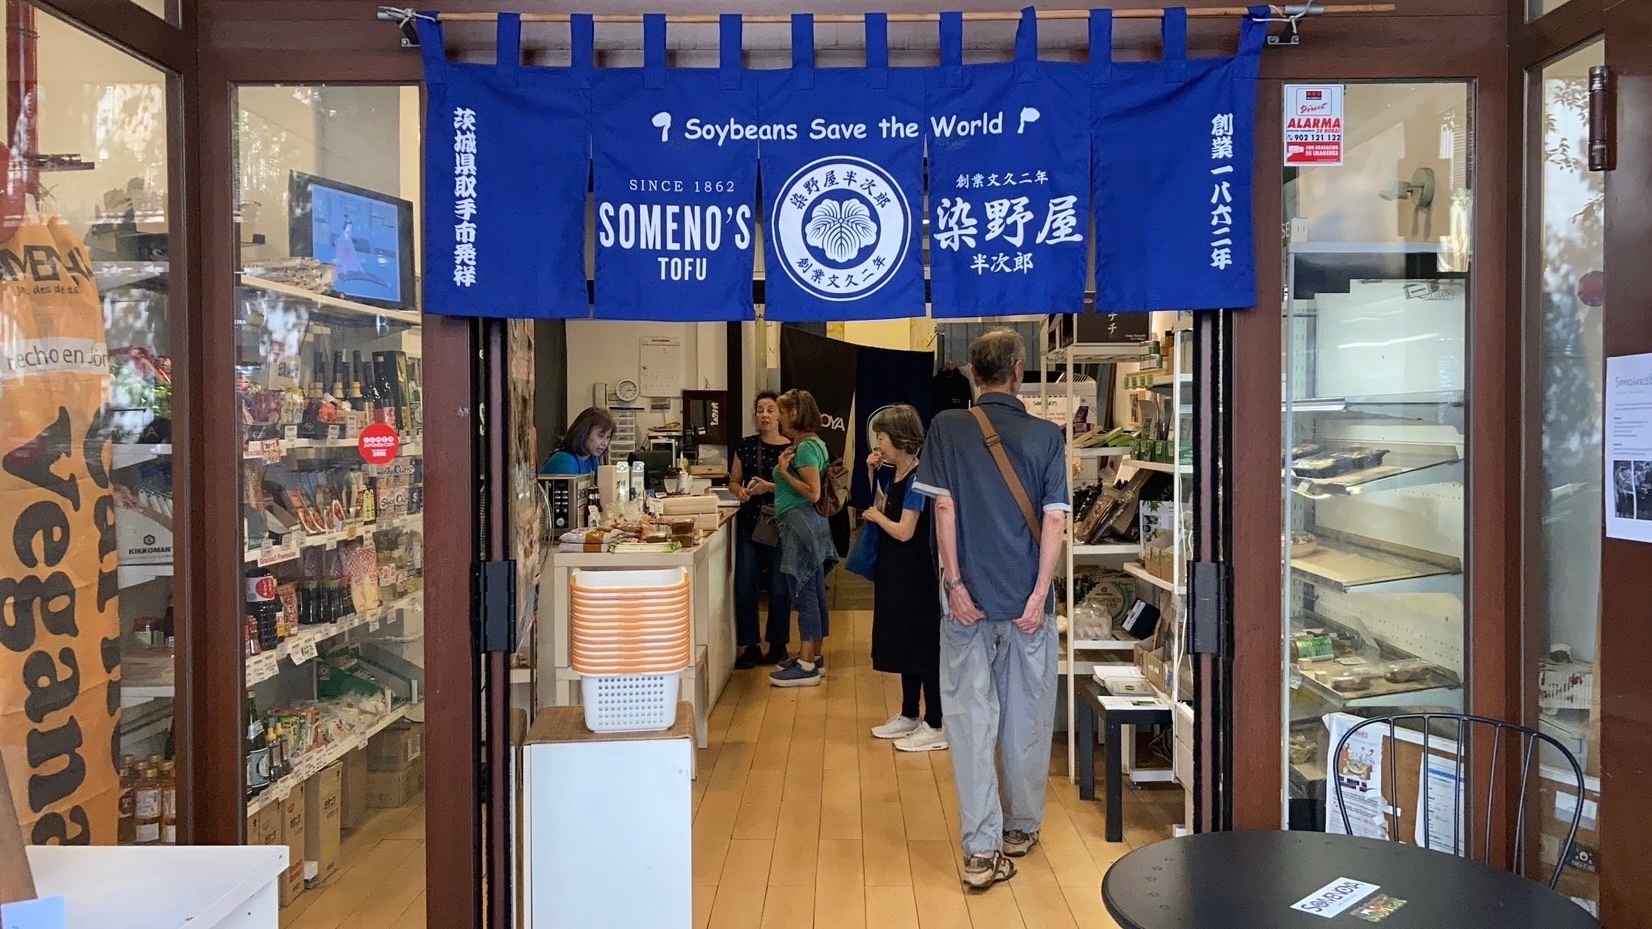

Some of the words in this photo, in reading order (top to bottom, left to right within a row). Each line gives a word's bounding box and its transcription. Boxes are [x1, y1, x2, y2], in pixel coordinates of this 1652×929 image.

[685, 117, 798, 146] Soybeans
[809, 118, 867, 140] Save
[879, 114, 920, 138] the
[931, 111, 1003, 138] World
[1287, 117, 1341, 128] ALARMA
[629, 178, 684, 193] SINCE
[694, 179, 735, 193] 1862
[790, 170, 891, 210] 染野屋半次郎
[956, 169, 1049, 189] 創業文久二年
[1210, 113, 1234, 270] 創業一八六二年
[454, 107, 477, 287] 茨城県取手市発祥
[599, 201, 752, 251] SOMENO'S
[933, 195, 1083, 251] 染野屋
[657, 257, 707, 281] TOFU
[796, 256, 887, 288] 創業文久二年
[970, 252, 1034, 276] 半次郎
[63, 349, 84, 363] en
[128, 547, 171, 555] KIKKOMAN
